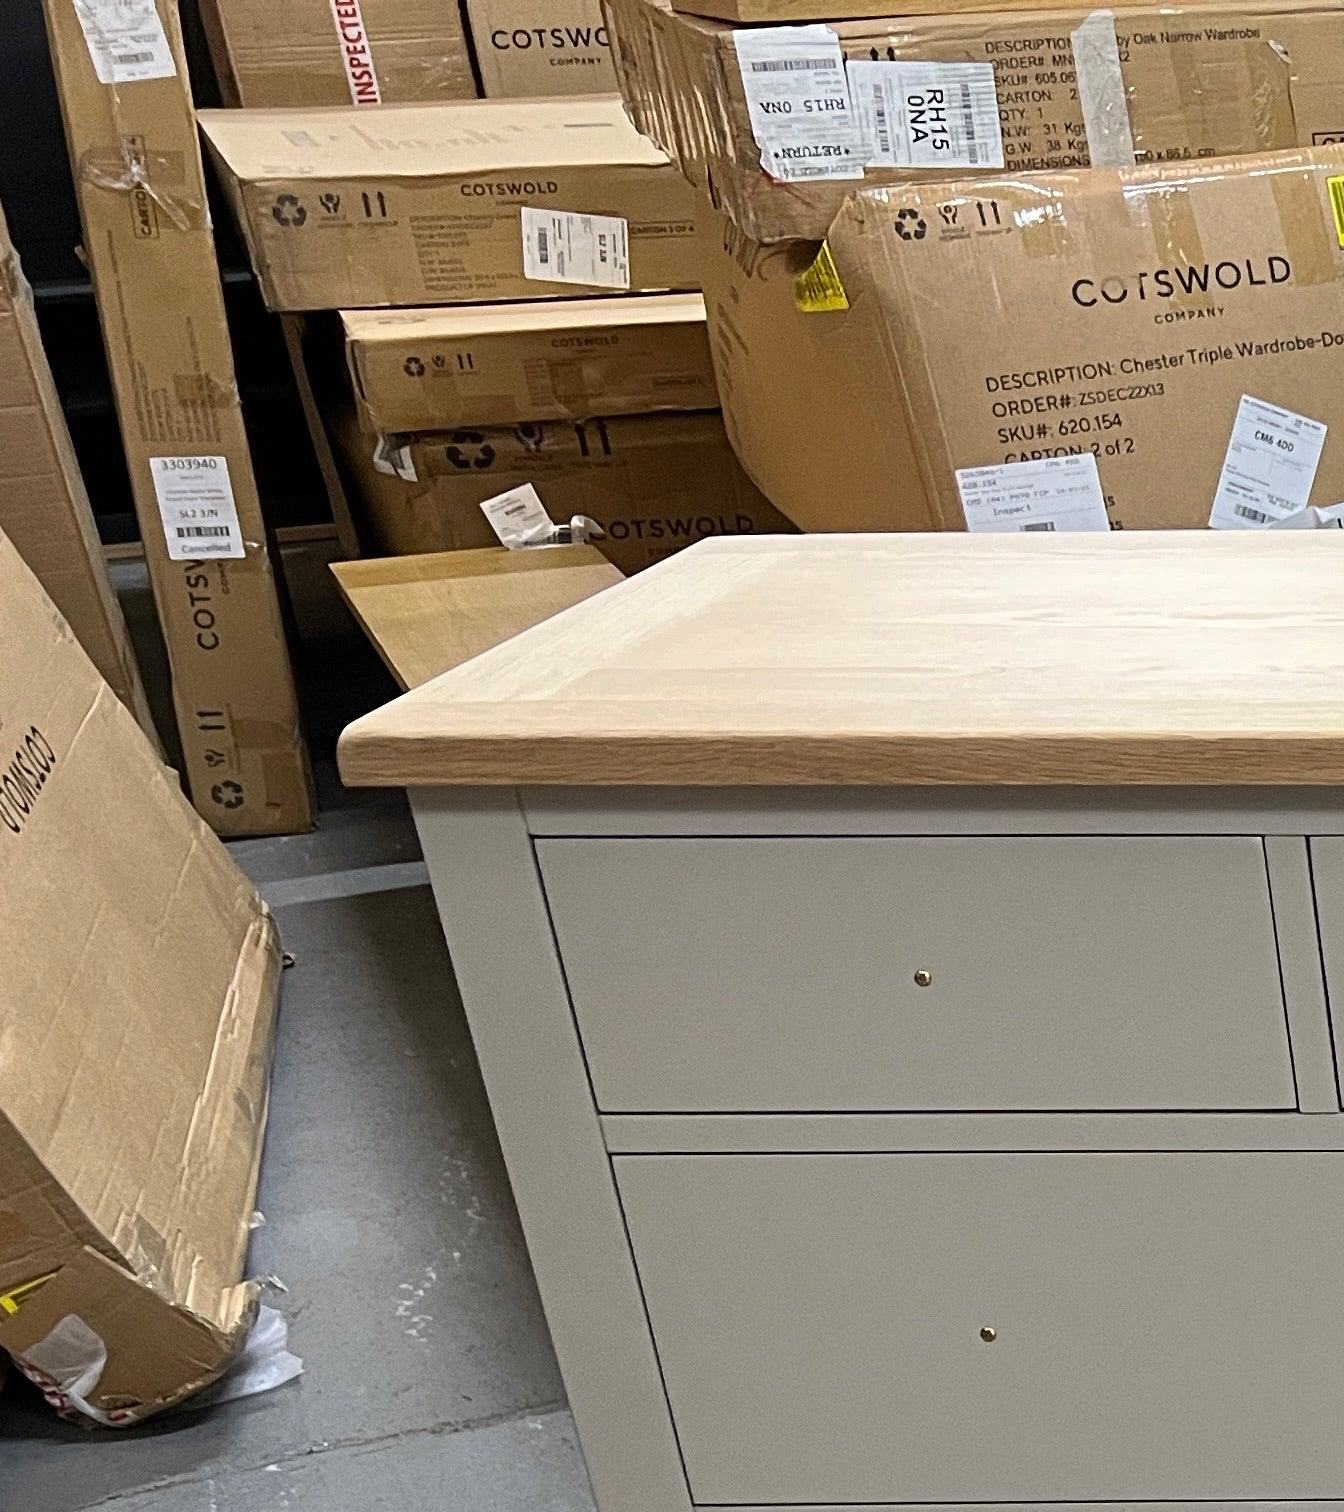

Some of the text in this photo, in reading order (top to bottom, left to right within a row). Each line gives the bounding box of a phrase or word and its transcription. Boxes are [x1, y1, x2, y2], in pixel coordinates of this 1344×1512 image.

[491, 27, 610, 50] COTSWO
[1133, 33, 1158, 45] Oak
[1160, 32, 1202, 44] Narrow
[1203, 28, 1260, 41] Wardrobe
[1035, 71, 1077, 85] 605.06
[803, 97, 845, 112] RH15
[926, 89, 950, 150] RH15
[461, 181, 558, 196] COTSWOLD
[1072, 256, 1291, 307] COTSWOLD
[1154, 306, 1225, 325] COMPANY
[986, 361, 1117, 392] DESCRIPTION:
[1119, 354, 1185, 375] Chester
[1187, 347, 1233, 367] Triple
[1058, 412, 1123, 436] 620.154
[1105, 439, 1120, 456] of
[1124, 438, 1136, 454] 2
[161, 459, 217, 471] 3303940
